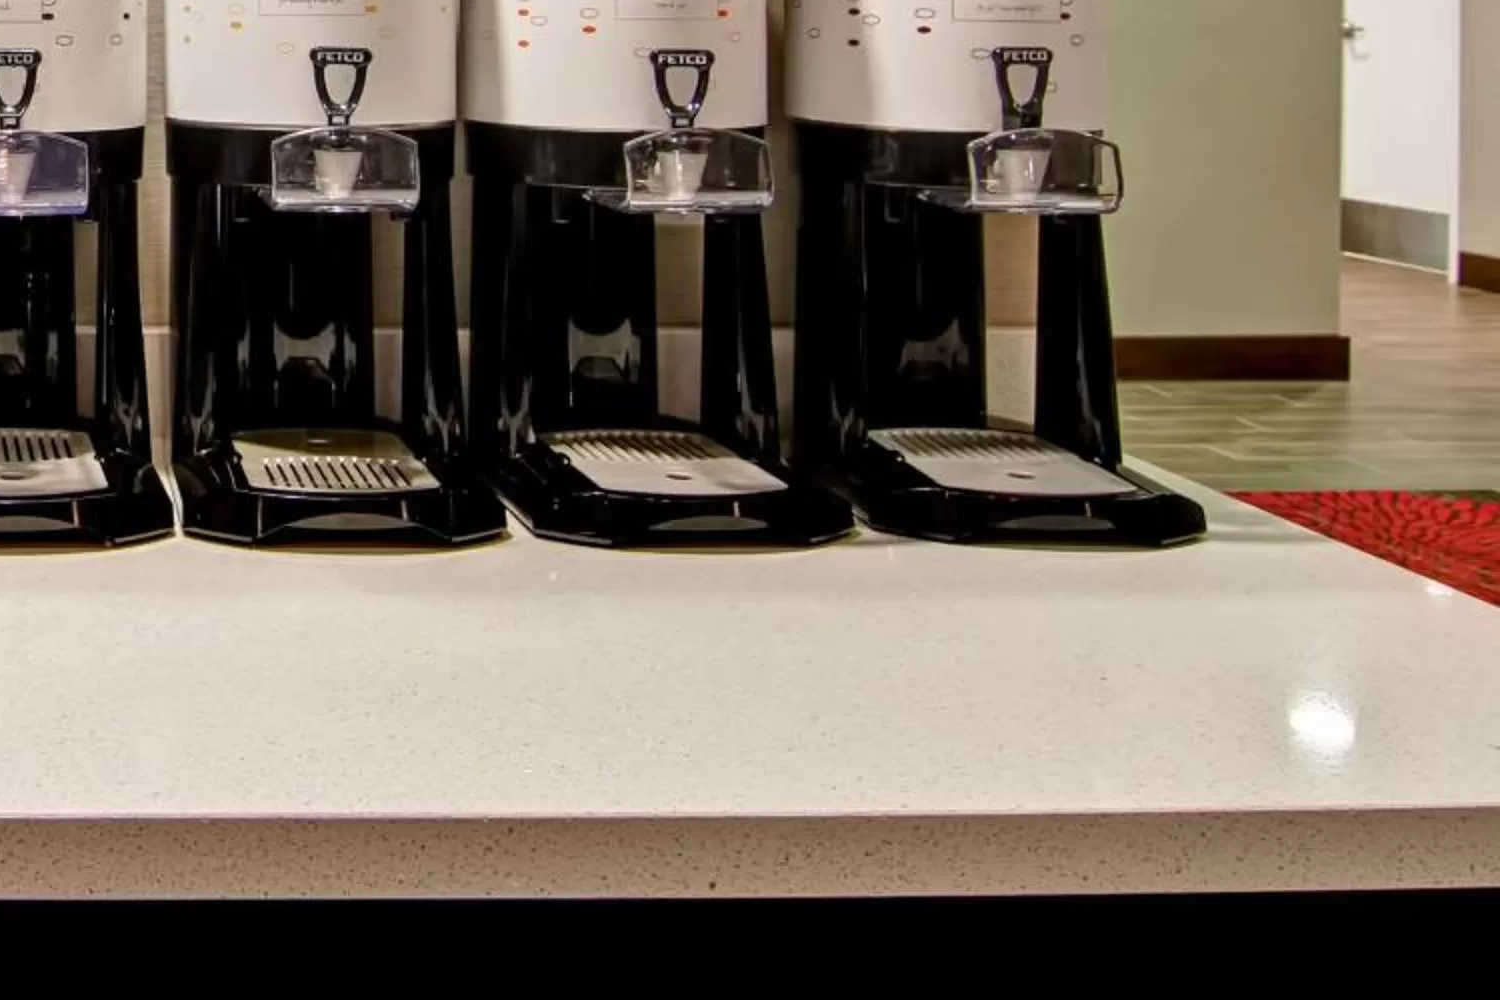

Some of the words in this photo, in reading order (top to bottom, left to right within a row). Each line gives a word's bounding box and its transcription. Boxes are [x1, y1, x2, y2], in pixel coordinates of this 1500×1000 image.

[317, 51, 364, 63] FETCO
[658, 54, 707, 65] FETCO
[1003, 51, 1047, 62] FETCO
